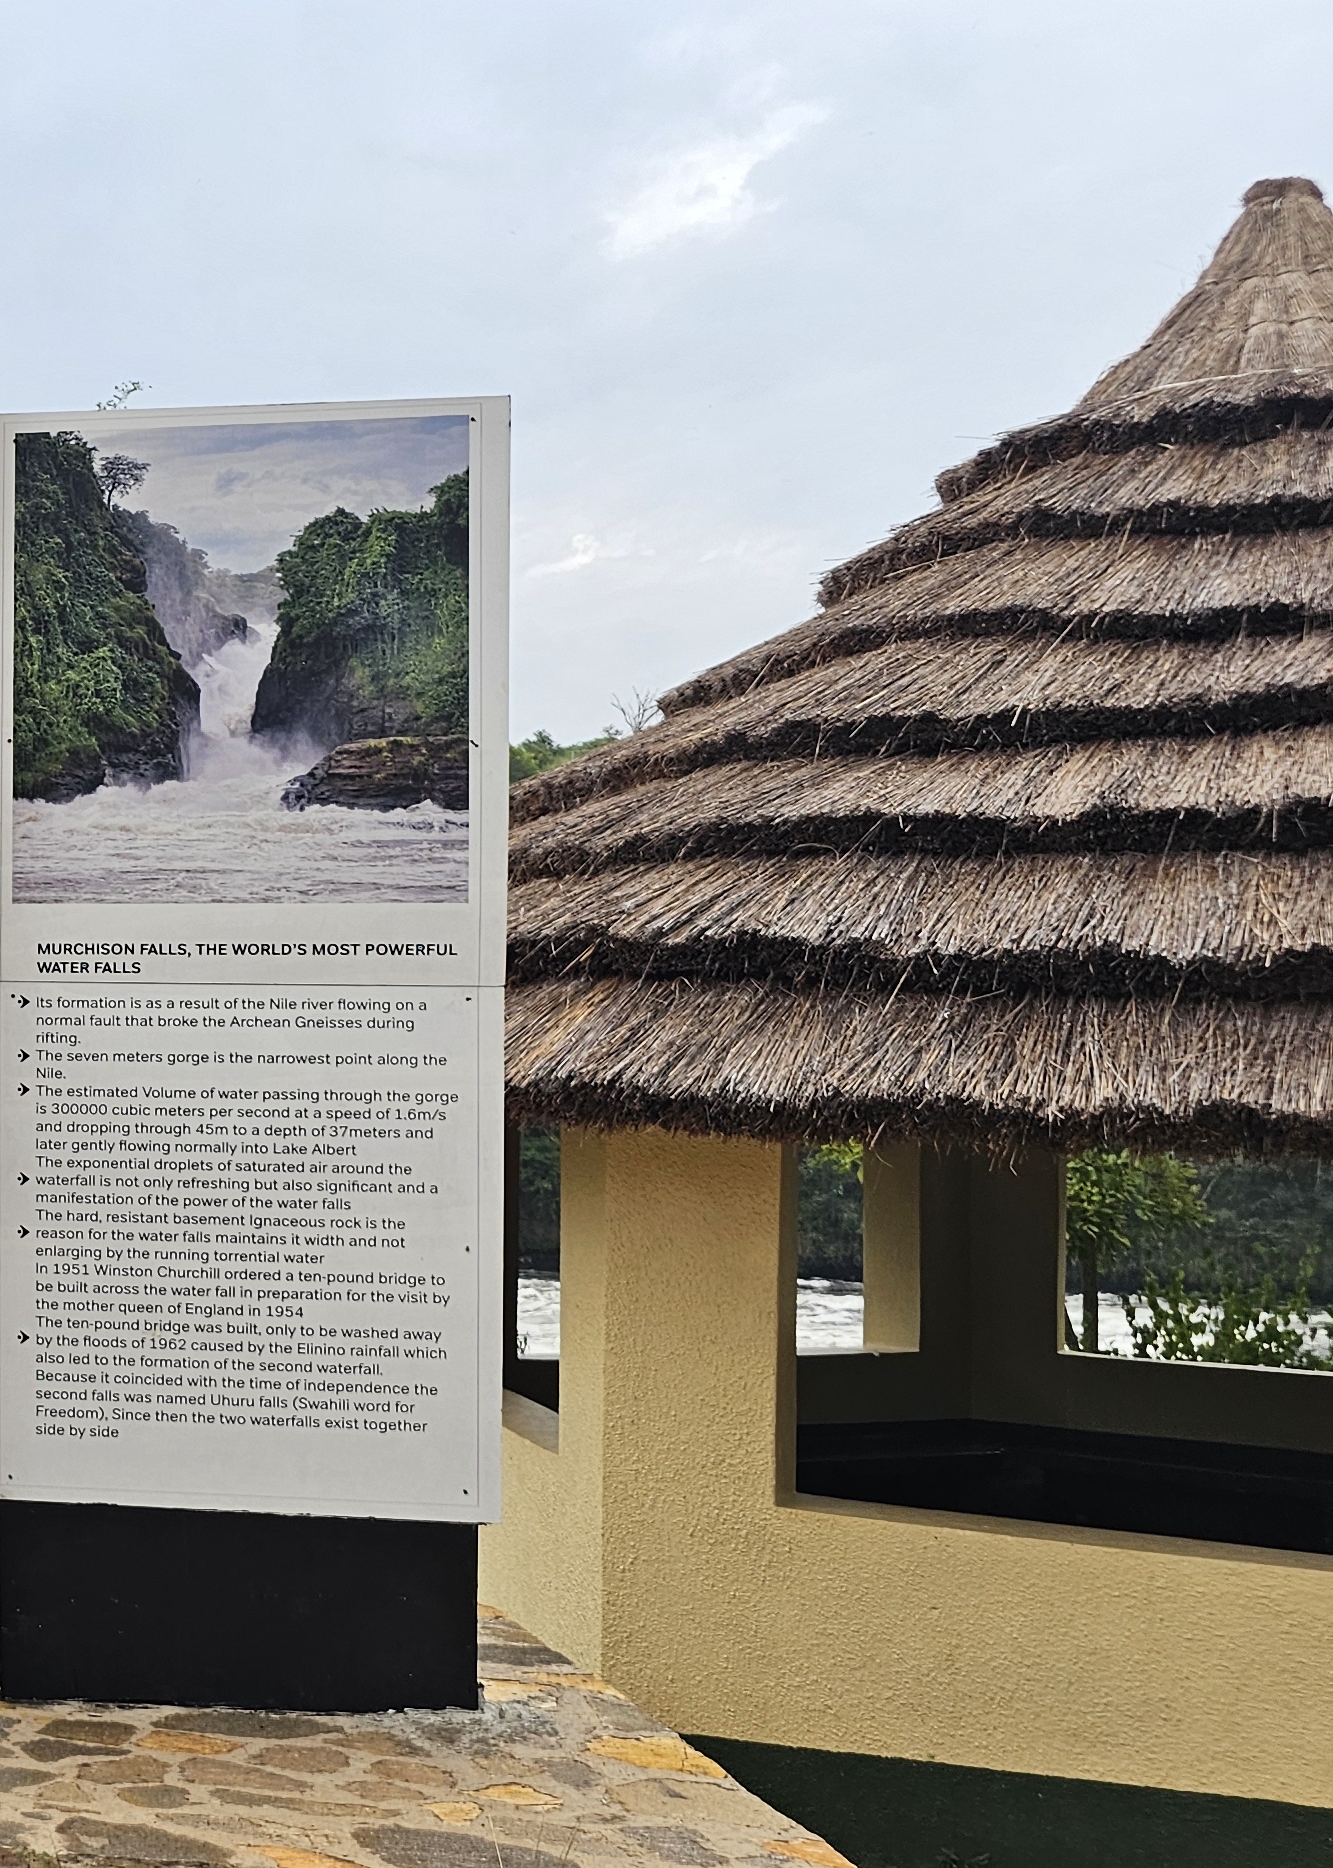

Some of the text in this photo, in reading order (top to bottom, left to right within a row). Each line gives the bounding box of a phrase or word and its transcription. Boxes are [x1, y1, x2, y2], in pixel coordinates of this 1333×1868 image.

[37, 943, 135, 956] MURCHISON
[140, 943, 192, 958] FALLS,
[195, 943, 228, 956] THE
[312, 944, 362, 956] MOST
[365, 943, 459, 956] POWERFUL
[36, 961, 142, 974] WATER FALLS
[36, 996, 428, 1014] Its formation is as a result of the Nile river flowing on a
[36, 1014, 415, 1033] normal fault that broke the Archean Gneisses during
[36, 1031, 82, 1047] rifting.
[36, 1067, 67, 1080] Nile.
[35, 1085, 459, 1106] The estimated Volume of water passing through the gorge
[35, 1120, 434, 1140] and dropping through 45m to a depth of 37meters and
[35, 1138, 358, 1157] later gently flowing normally into Lake Albert
[35, 1174, 439, 1195] waterfall is not only refreshing but also significant and a
[35, 1209, 406, 1230] The hard, resistant basement Ignaceous rock is the
[35, 1244, 326, 1264] enlarging by the running torrential water
[36, 1262, 446, 1289] In 1951 Winston Churchill ordered a ten-pound bridge to
[35, 1297, 304, 1319] the mother queen of England in 1954
[35, 1315, 442, 1344] The ten-pound bridge was built, only to be washed away
[35, 1351, 384, 1376] also led to the formation of the second waterfall.
[36, 1369, 439, 1396] Because it coincided with the time of independence the
[112, 1407, 152, 1422] Since
[155, 1410, 188, 1423] then
[192, 1411, 216, 1424] the
[219, 1412, 247, 1426] two
[250, 1414, 321, 1429] waterfalls
[325, 1416, 360, 1430] exist
[363, 1418, 428, 1434] together
